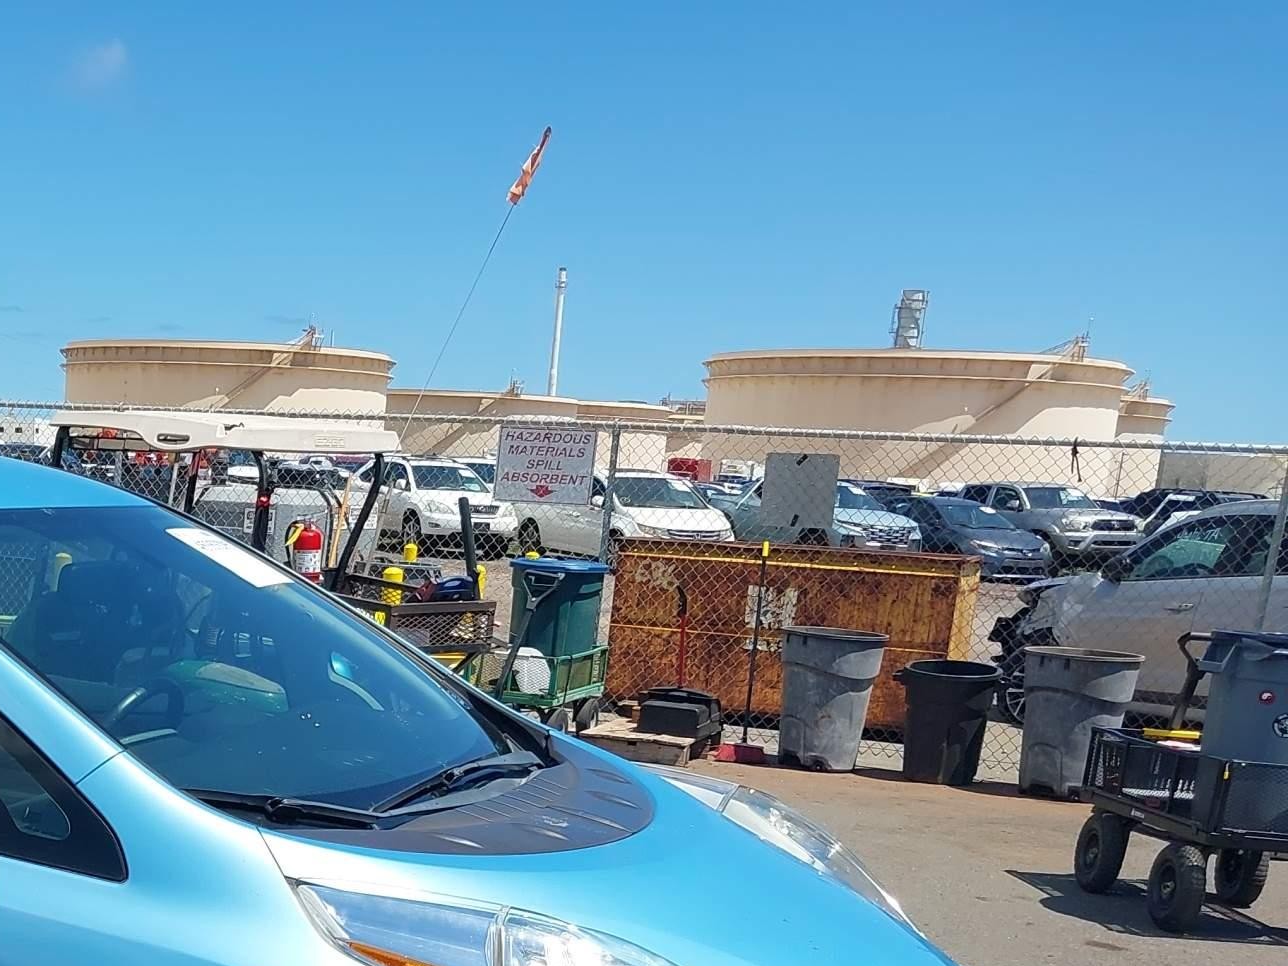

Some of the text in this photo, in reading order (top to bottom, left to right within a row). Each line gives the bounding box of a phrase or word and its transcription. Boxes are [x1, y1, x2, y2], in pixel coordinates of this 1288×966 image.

[505, 431, 592, 445] HAZARDOUS
[507, 445, 586, 458] MATERIALS
[526, 459, 563, 471] SPILL
[500, 471, 588, 486] ABSORBENT
